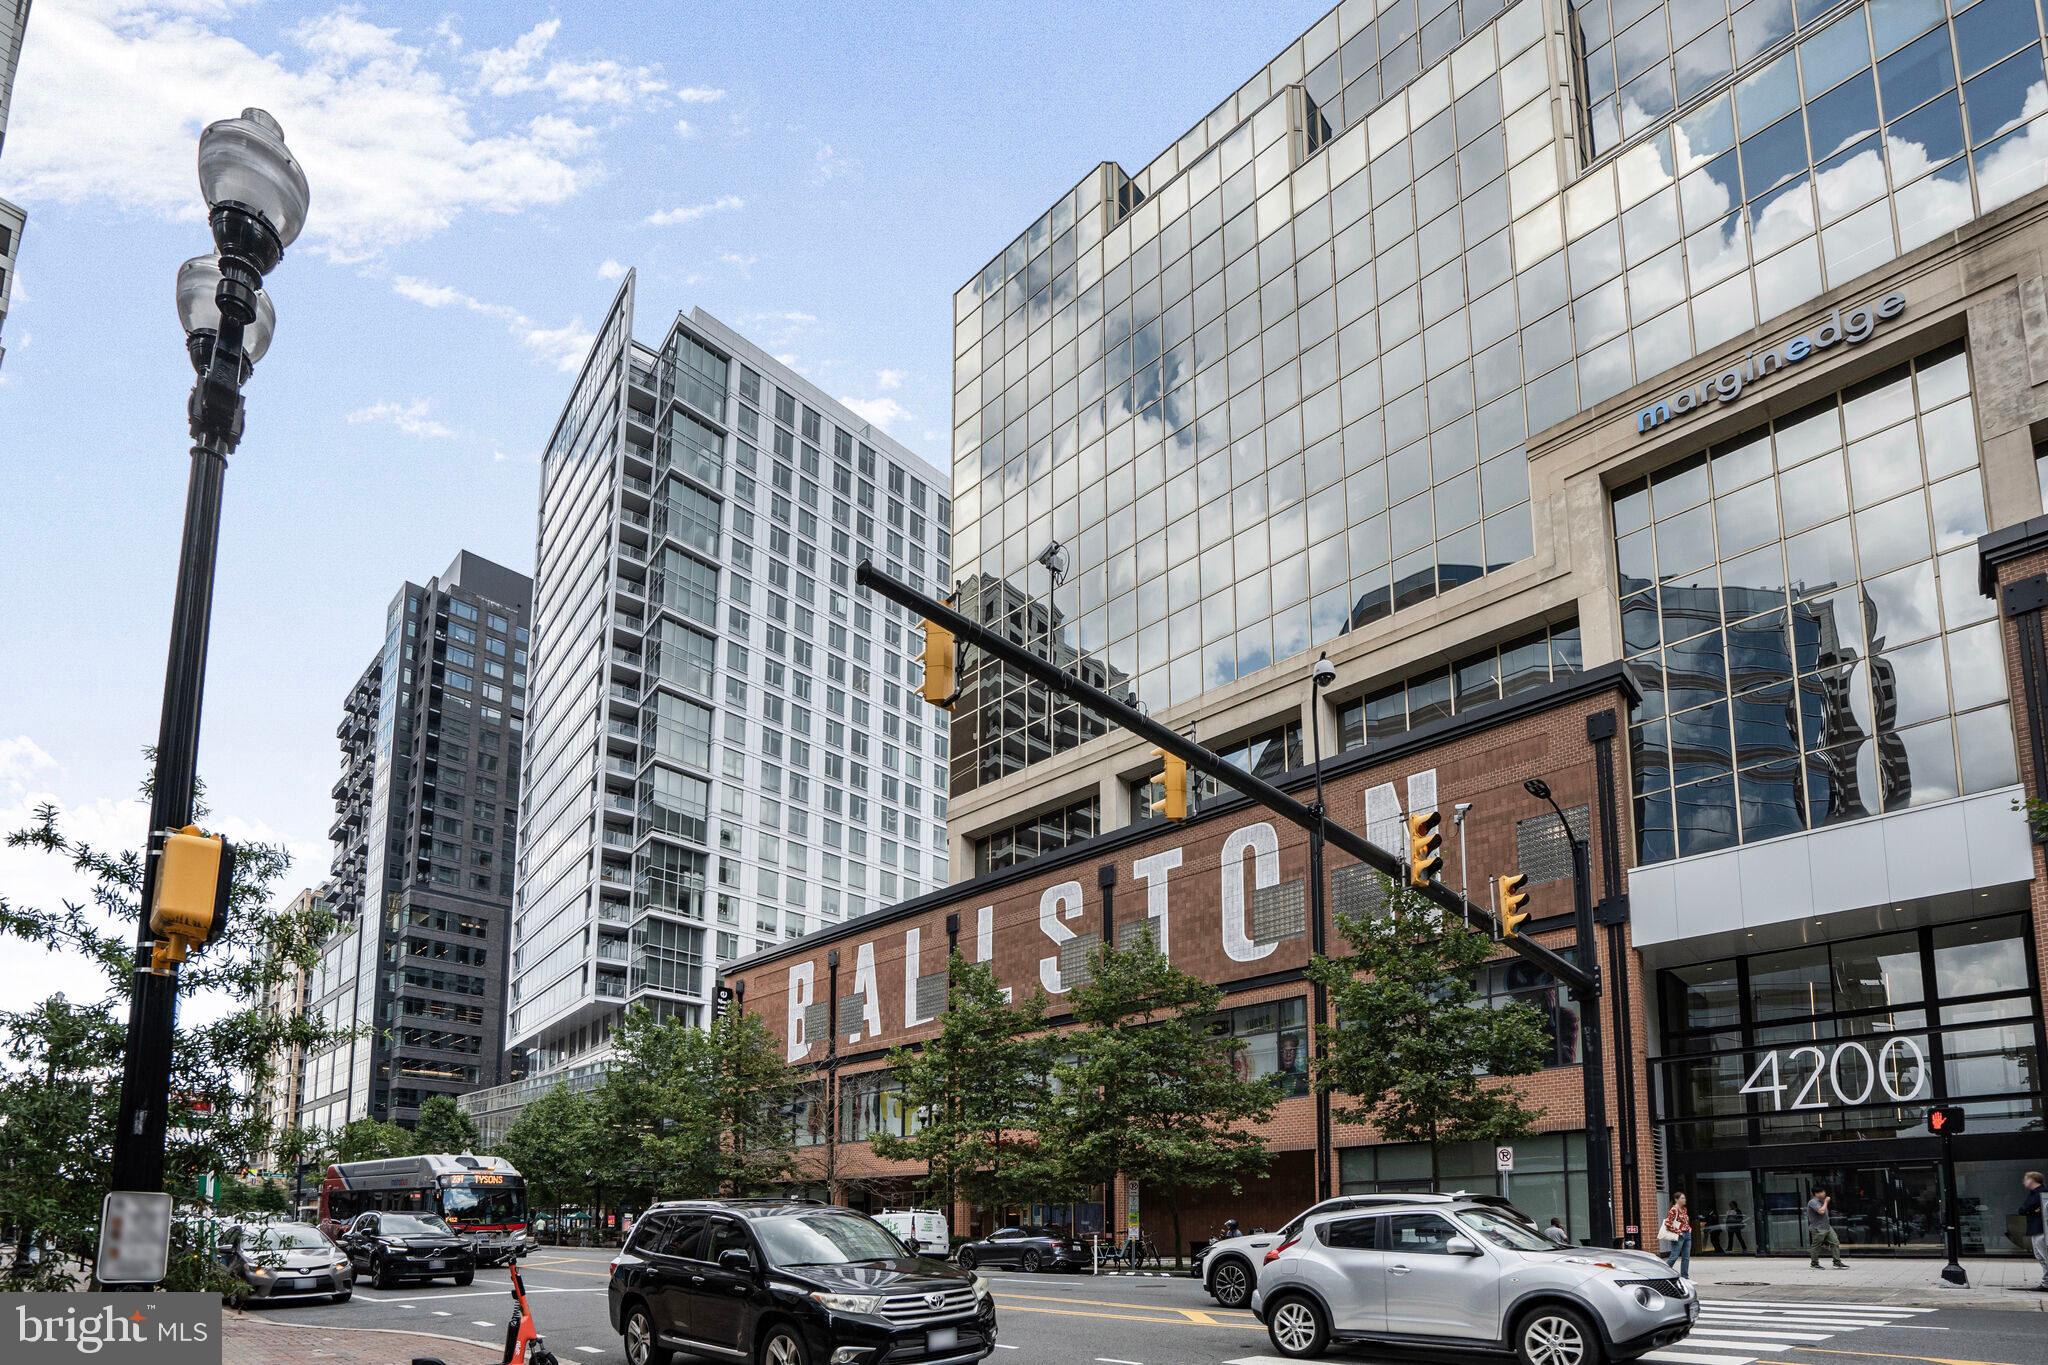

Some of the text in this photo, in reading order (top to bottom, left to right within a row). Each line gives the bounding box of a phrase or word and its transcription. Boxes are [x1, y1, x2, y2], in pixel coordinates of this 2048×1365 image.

[1636, 291, 1906, 434] marginedge
[787, 767, 1443, 1064] BALLSTON
[1739, 1036, 1925, 1111] 4200
[474, 1174, 504, 1184] TYSONS
